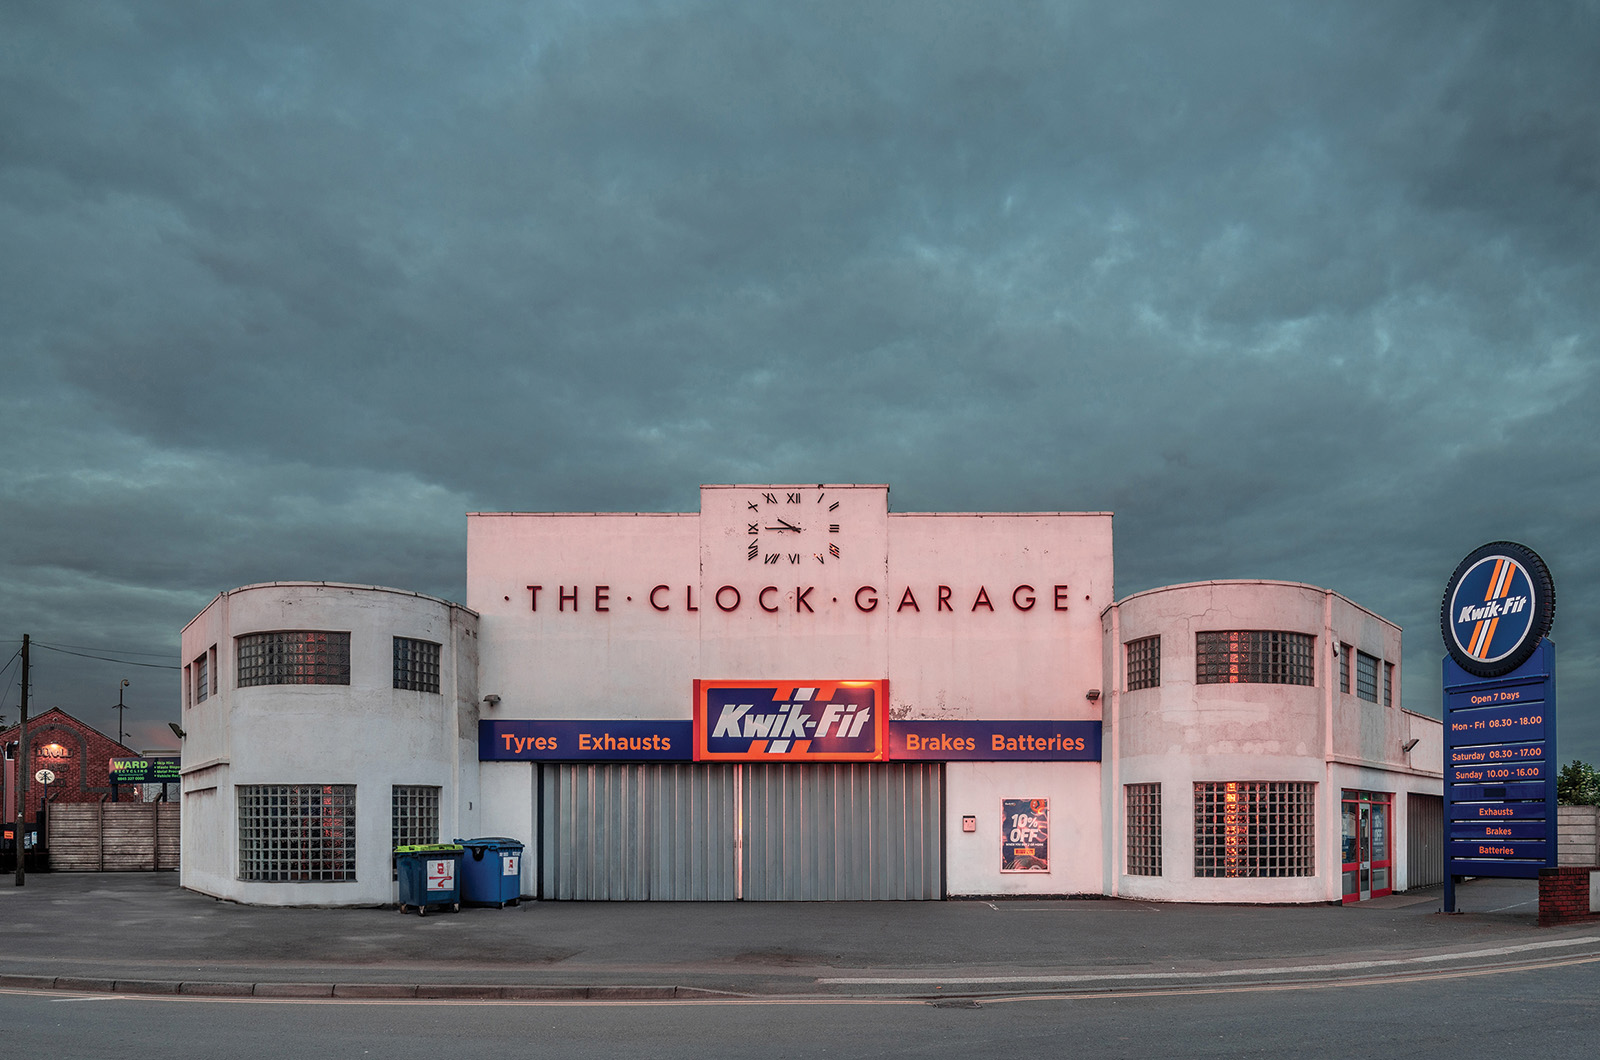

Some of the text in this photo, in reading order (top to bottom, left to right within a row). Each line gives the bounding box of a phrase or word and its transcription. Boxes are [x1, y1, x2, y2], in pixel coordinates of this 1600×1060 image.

[762, 493, 778, 504] XI
[787, 493, 801, 504] XII
[748, 501, 759, 513] X
[829, 501, 840, 512] II
[748, 523, 759, 535] IX
[829, 524, 840, 533] III
[748, 538, 759, 561] VIII
[764, 553, 780, 565] VII
[788, 553, 800, 565] VI
[814, 553, 825, 565] V
[526, 584, 1069, 613] THE CLOCK GARAGE
[1458, 595, 1527, 624] Kwik-Fit
[1471, 692, 1520, 704] Open 7 Days
[711, 704, 871, 738] Kwik-Fit
[1452, 723, 1468, 731] Mon
[1474, 721, 1485, 729] Fri
[1489, 718, 1512, 728] 08.30
[1519, 716, 1542, 725] 18.00
[501, 733, 671, 753] Tyres Exhausts
[906, 733, 1085, 751] Brakes Batteries
[1452, 752, 1485, 761] Saturday
[1489, 749, 1513, 759] 08.30
[1520, 747, 1542, 757] 17.00
[114, 761, 148, 769] WARD
[1455, 771, 1483, 780] Sunday
[1487, 769, 1509, 778] 10.00
[1516, 768, 1539, 777] 16.00
[1479, 808, 1514, 816] Exhausts
[1011, 813, 1038, 828] 10%
[1010, 828, 1038, 842] OFF
[1485, 827, 1512, 835] Brakes
[1479, 846, 1514, 855] Batteries
